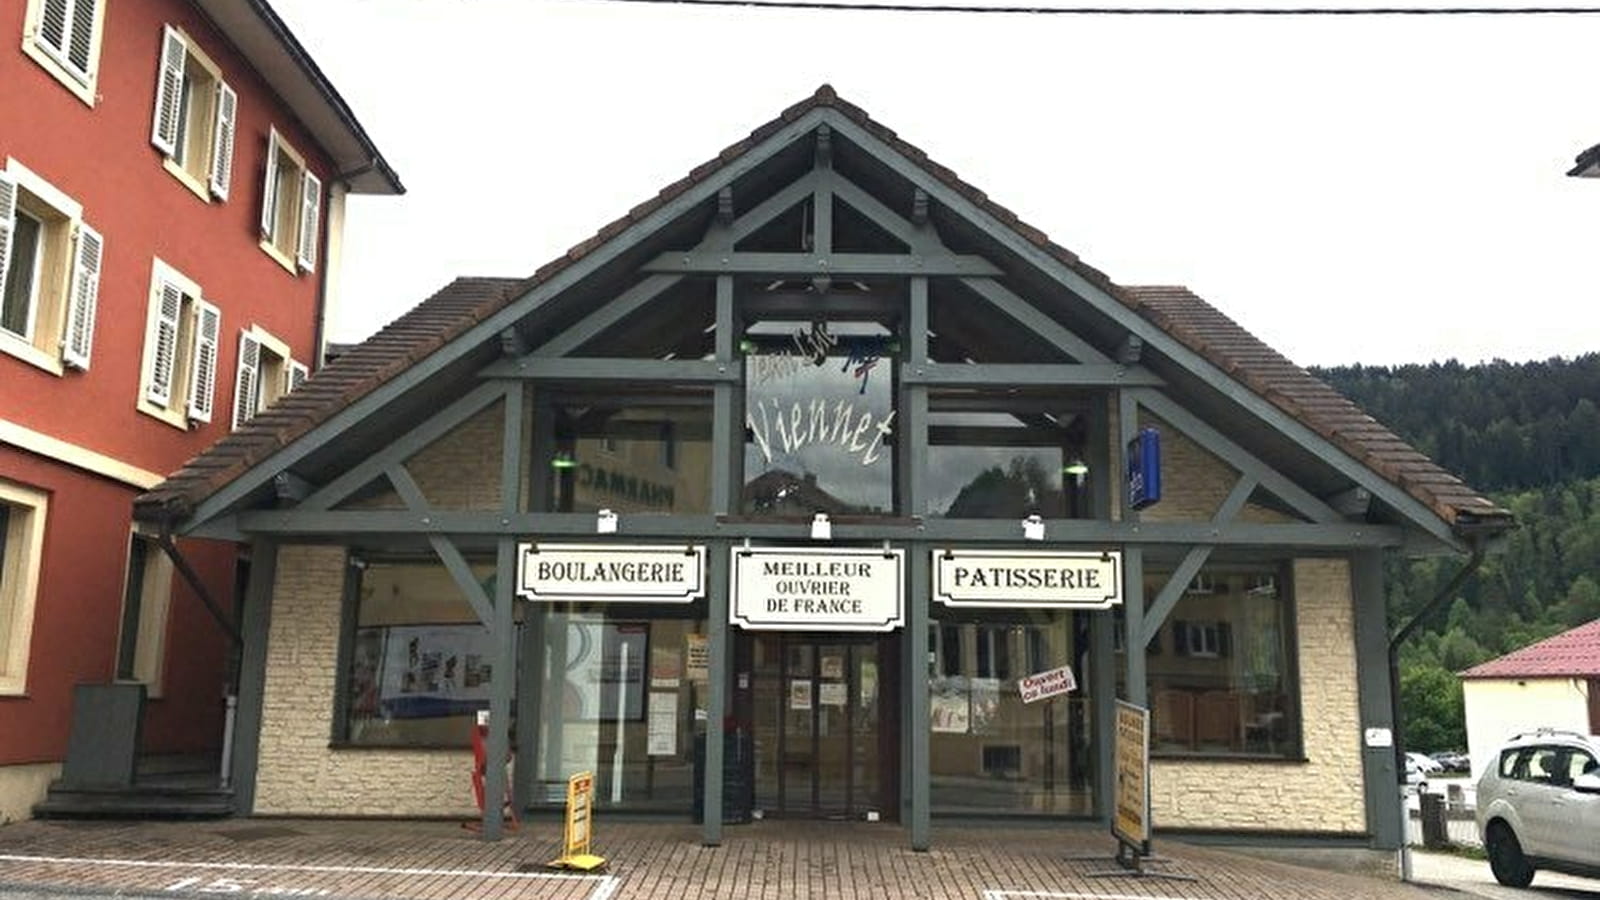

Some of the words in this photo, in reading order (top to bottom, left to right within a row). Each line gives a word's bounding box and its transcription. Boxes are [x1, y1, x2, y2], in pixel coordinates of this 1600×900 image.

[747, 398, 897, 464] Viennet
[538, 561, 684, 583] BOULANGERIE
[763, 561, 872, 578] MEILLEUR
[954, 567, 1101, 589] PATISSERIE
[775, 580, 850, 596] OUVRIER
[766, 598, 789, 613] DE
[793, 599, 863, 614] FRANCE
[1023, 669, 1065, 688] Ouvert
